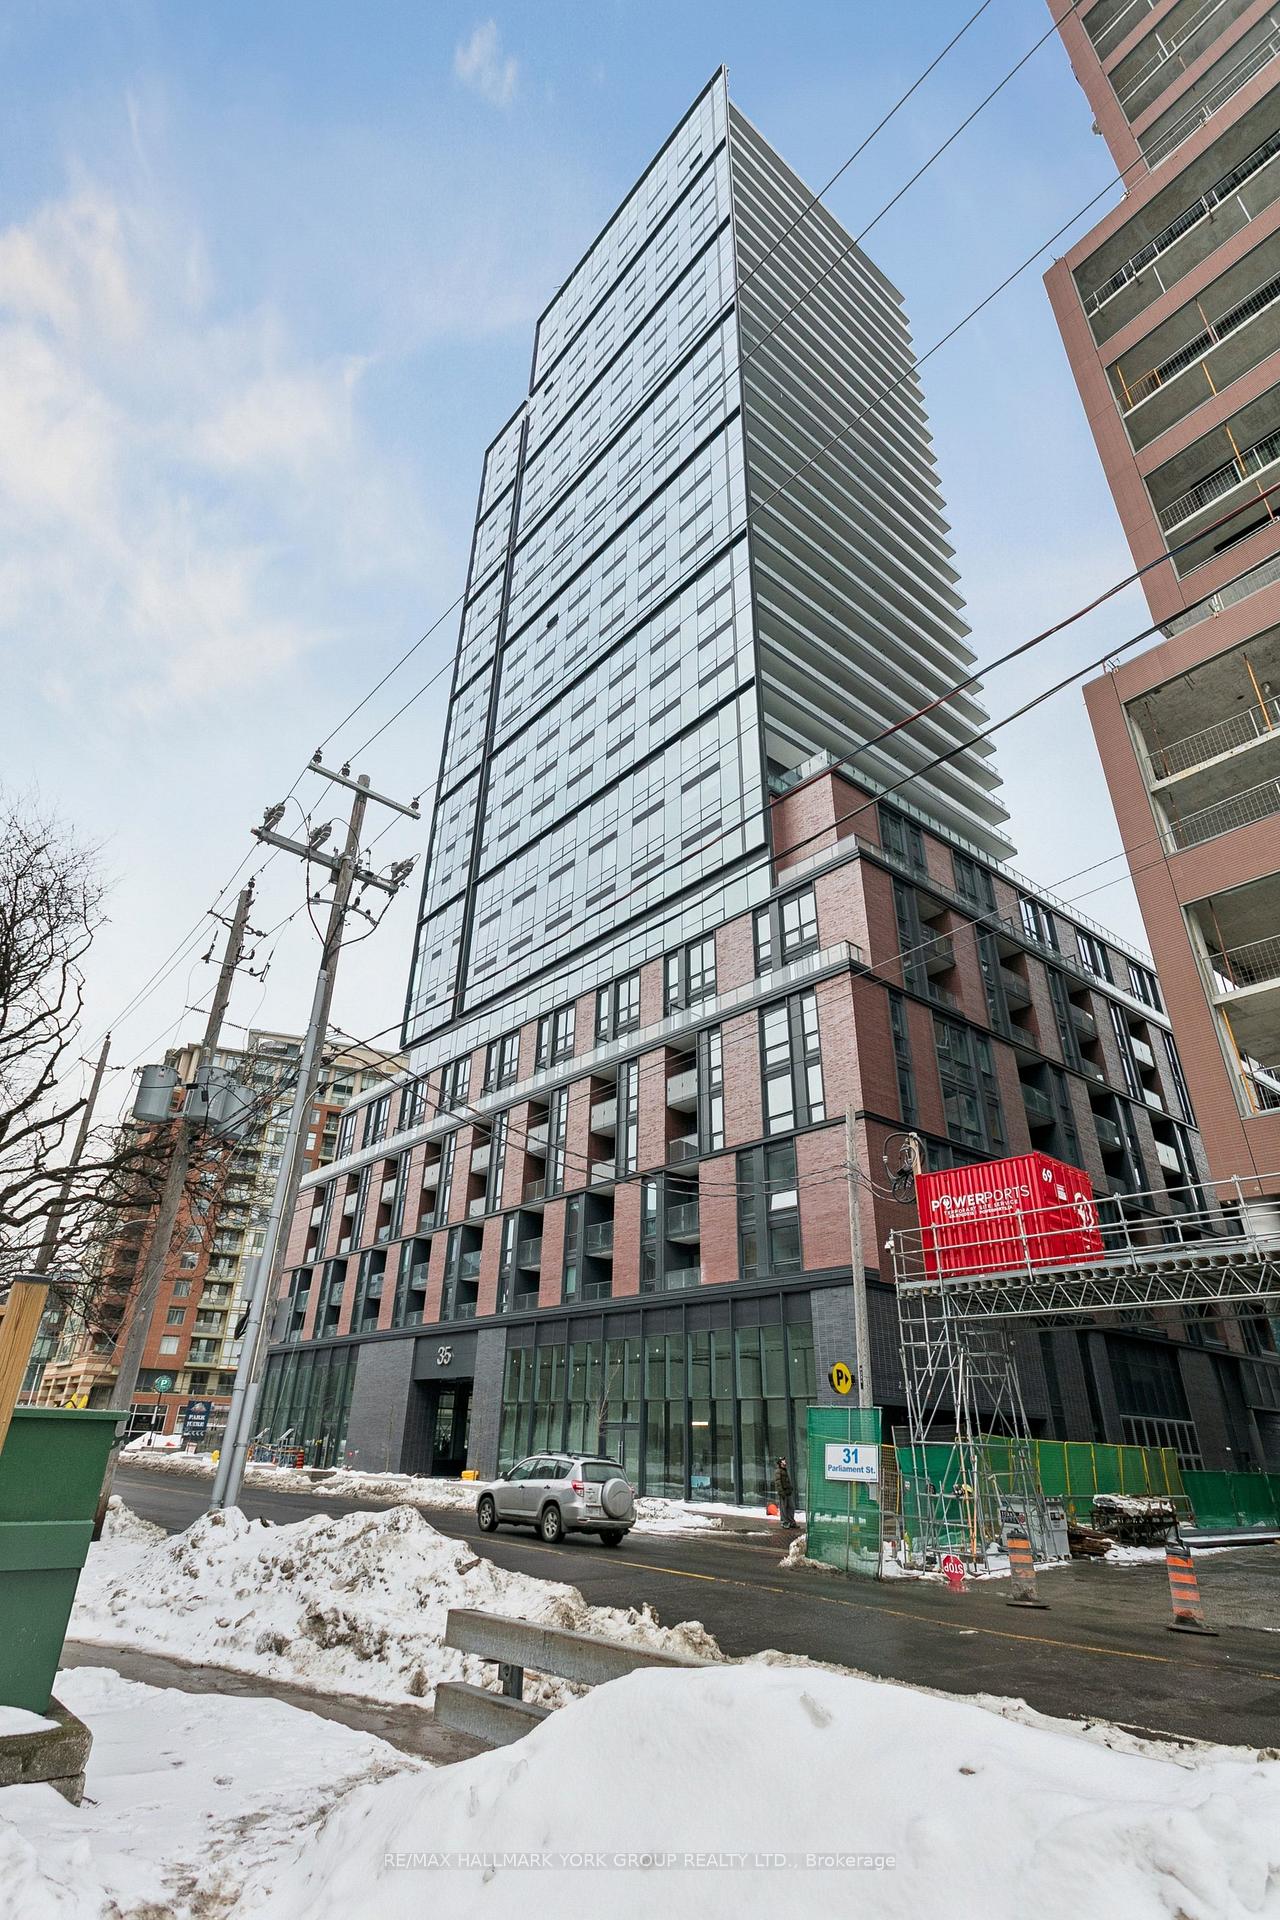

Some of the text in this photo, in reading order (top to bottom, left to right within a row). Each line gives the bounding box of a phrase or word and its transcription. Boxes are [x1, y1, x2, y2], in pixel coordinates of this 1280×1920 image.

[1042, 1168, 1052, 1183] 69
[931, 1184, 1030, 1212] POWERPORTS
[436, 1346, 452, 1365] 35
[842, 1448, 859, 1464] 31
[827, 1464, 876, 1474] Parliament St.
[943, 1561, 964, 1575] STOP
